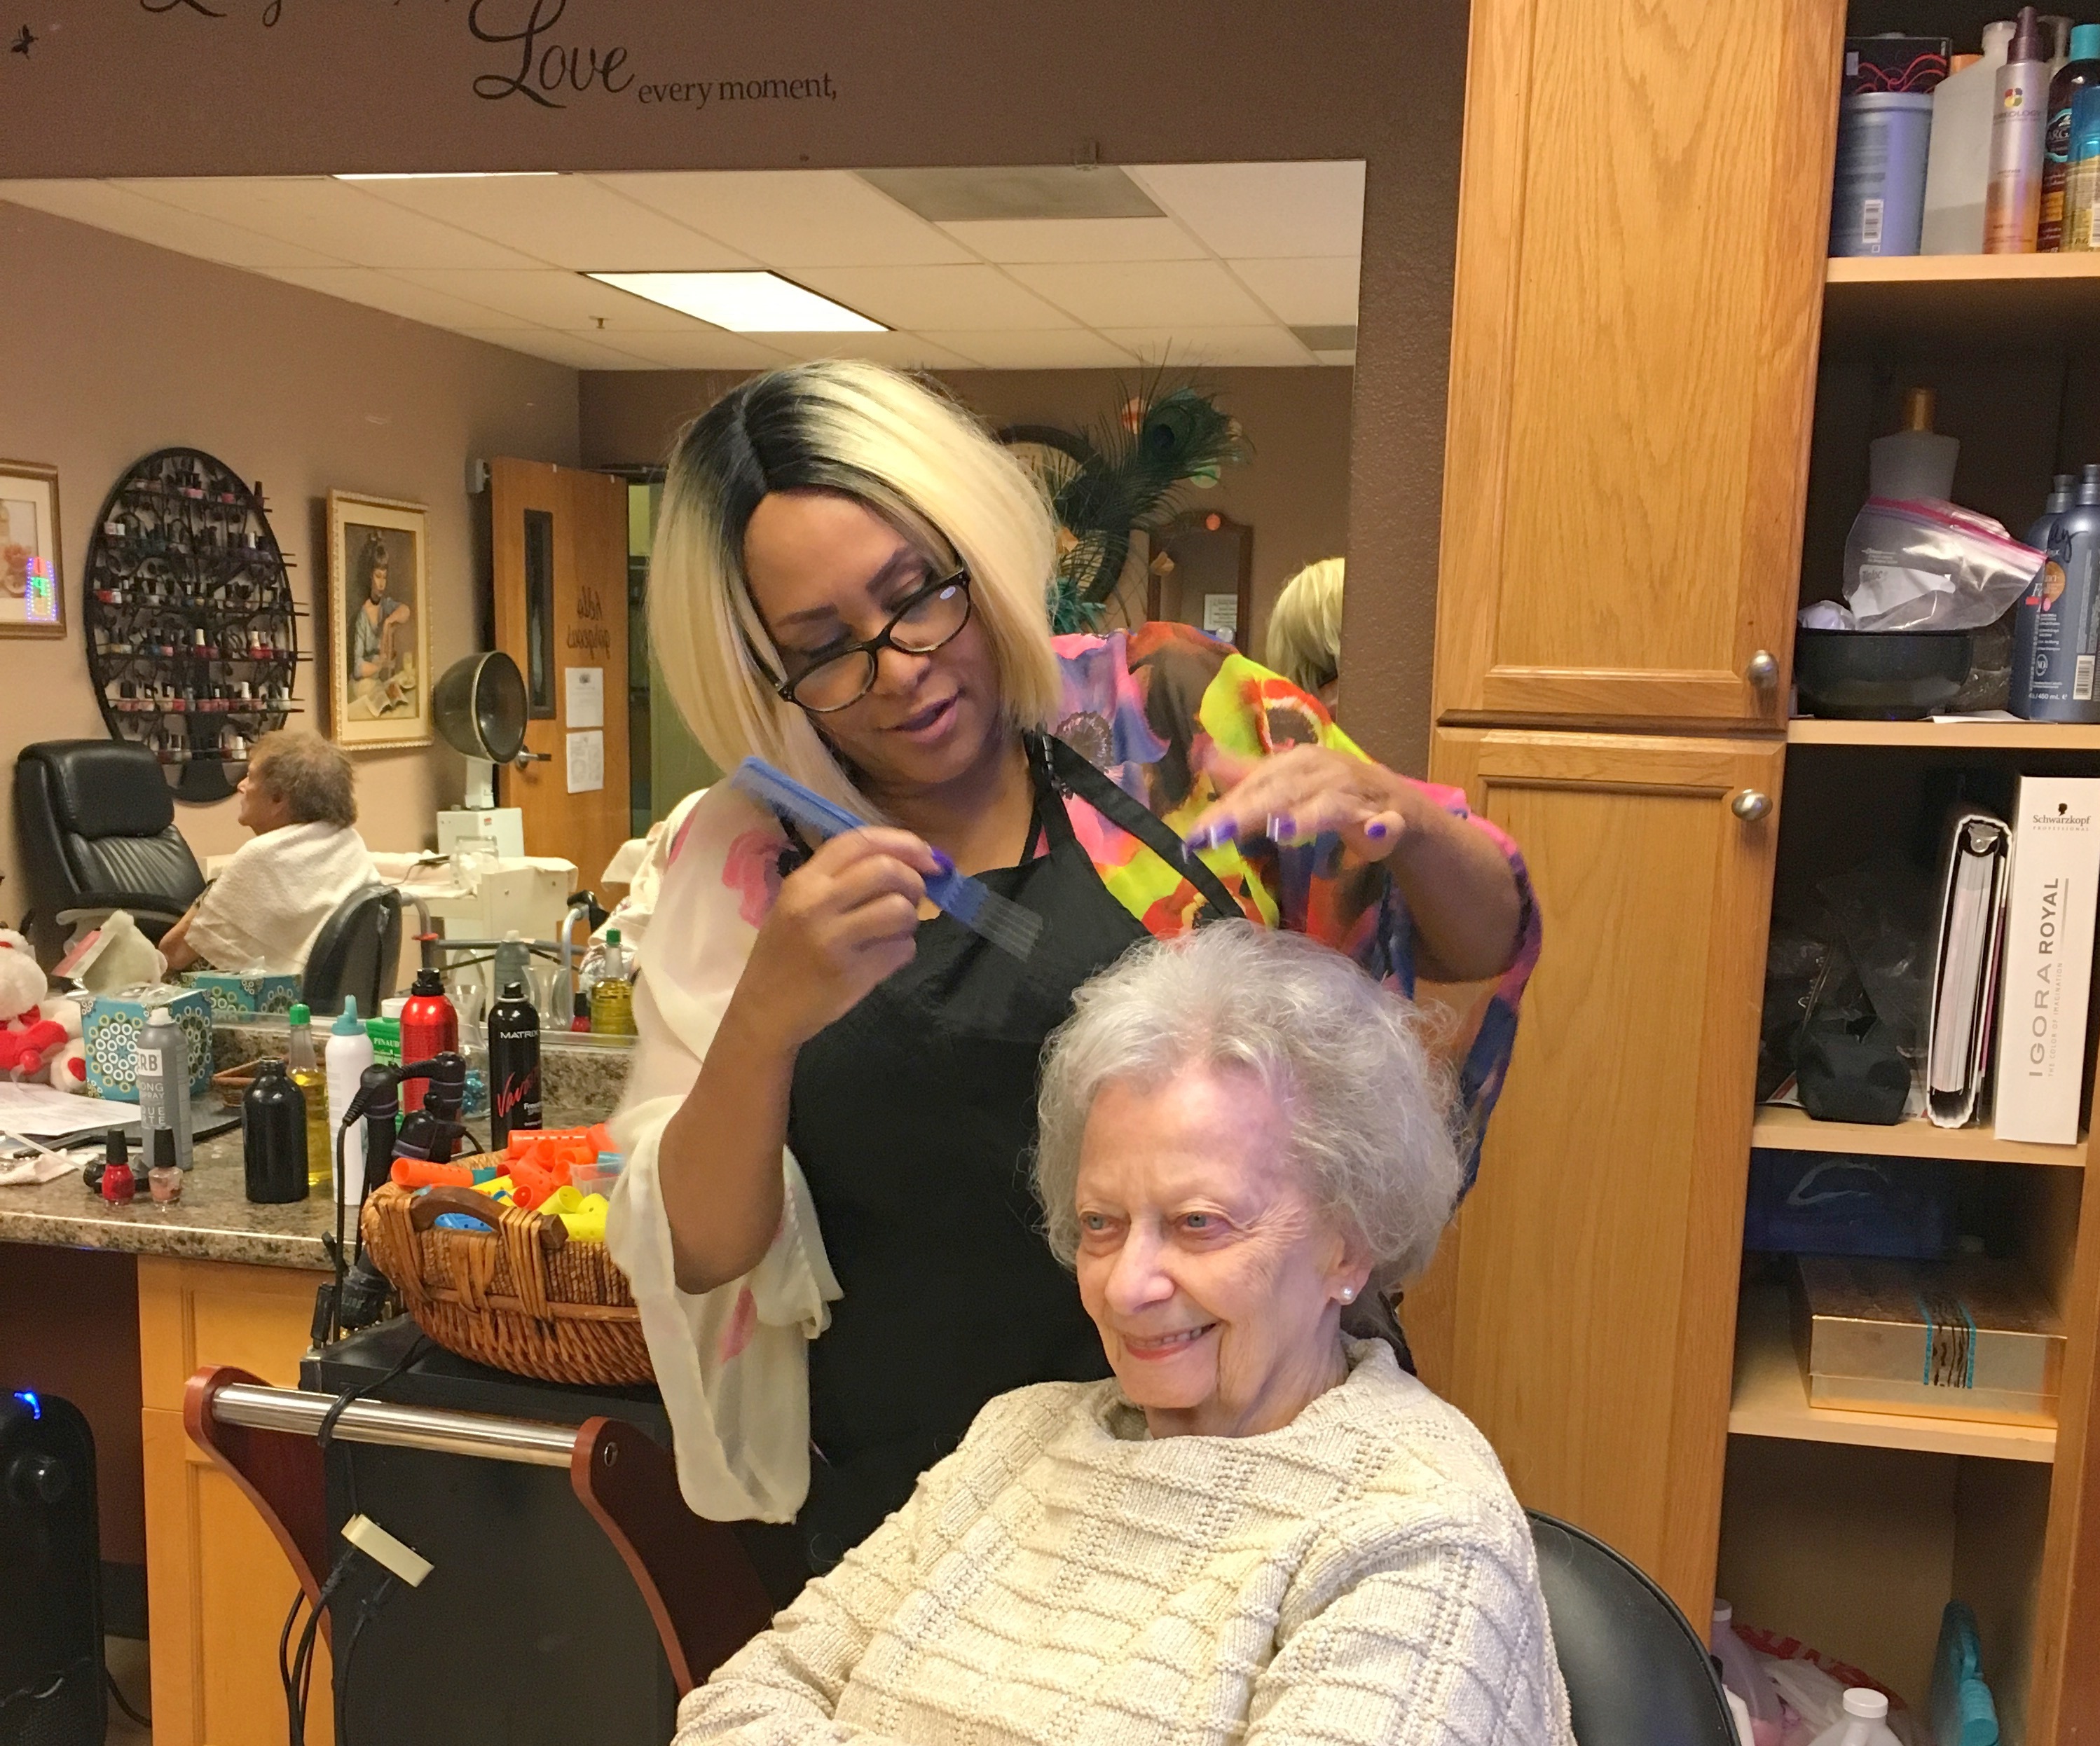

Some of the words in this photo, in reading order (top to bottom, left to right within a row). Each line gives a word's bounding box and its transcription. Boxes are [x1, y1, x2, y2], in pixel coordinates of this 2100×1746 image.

[469, 0, 635, 109] Love
[638, 81, 713, 109] every
[719, 72, 837, 102] moment,
[2033, 814, 2092, 827] Schwarzkopf
[2038, 878, 2059, 954] ROYAL
[2053, 963, 2063, 1016] IMAGINATION
[500, 1030, 539, 1039] MATRIX
[2029, 963, 2052, 1077] IGORA
[2052, 1019, 2058, 1030] OF
